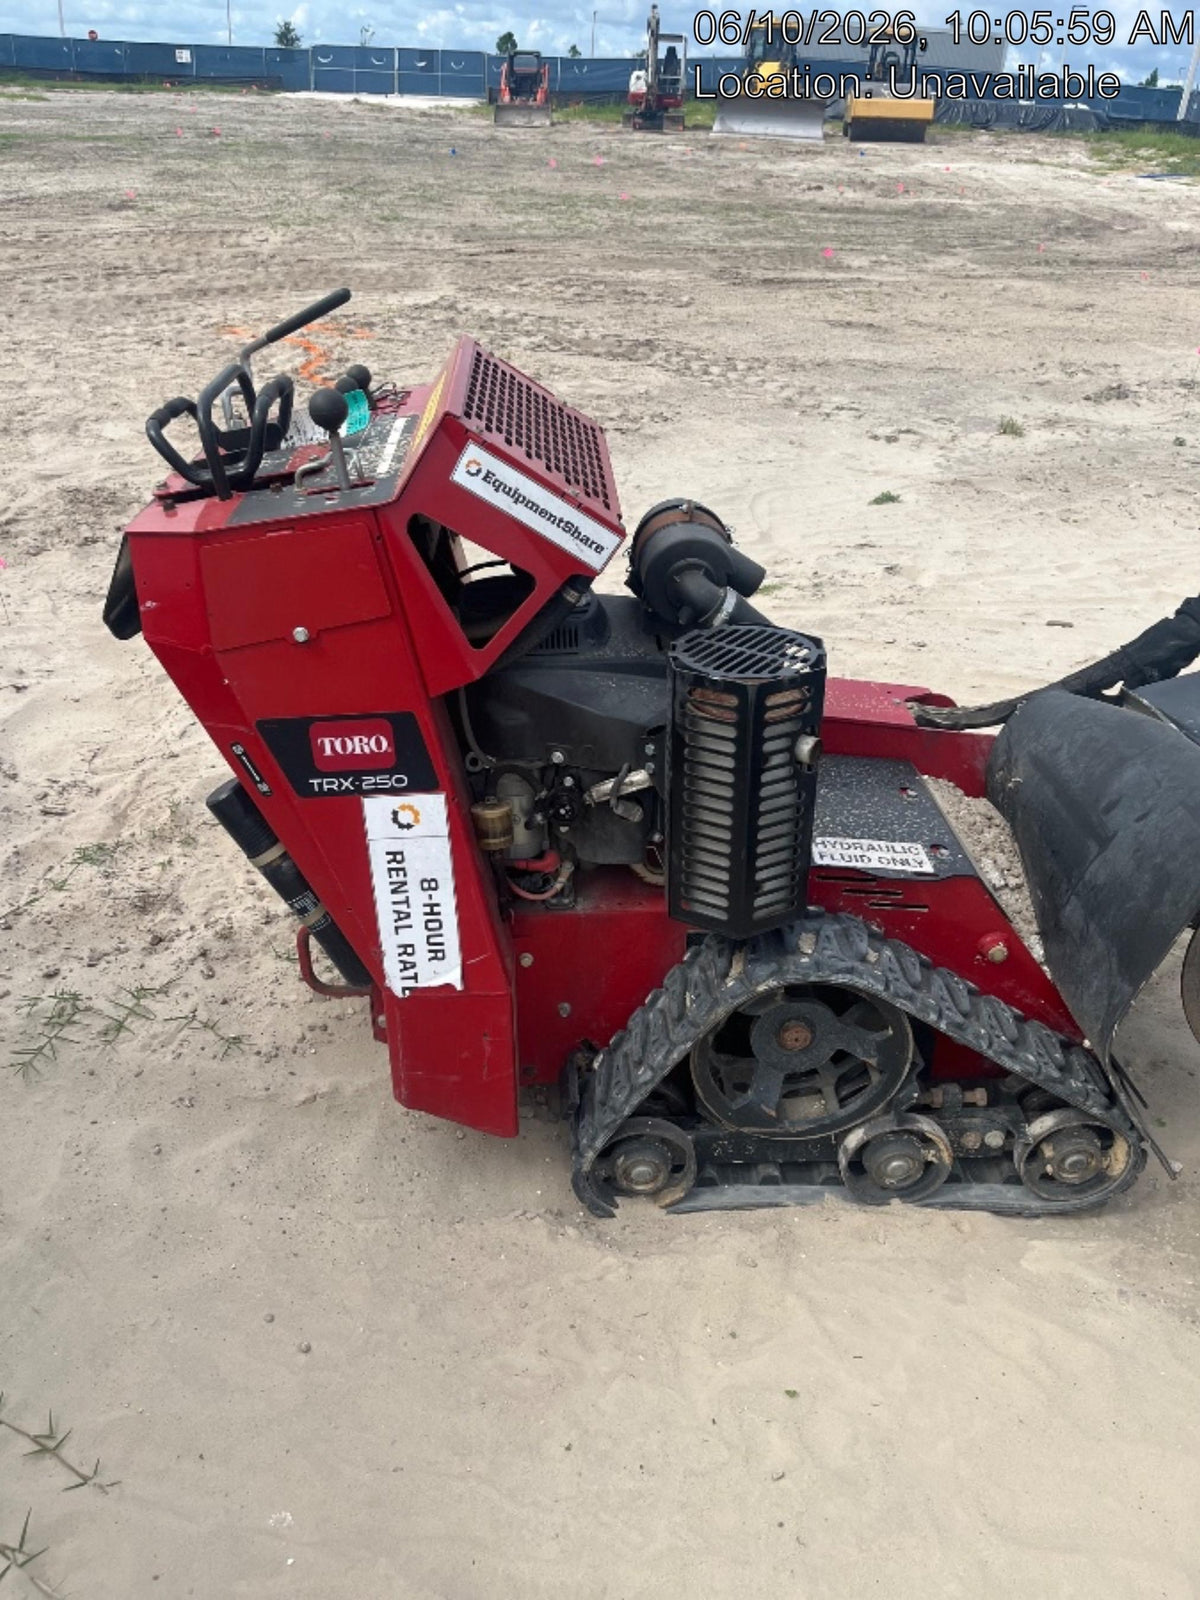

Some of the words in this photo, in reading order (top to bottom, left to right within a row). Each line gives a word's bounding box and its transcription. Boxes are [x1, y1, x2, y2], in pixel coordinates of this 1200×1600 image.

[481, 468, 606, 555] EquipmentShare
[317, 733, 389, 757] TORO
[309, 774, 408, 792] TRX-250
[818, 851, 872, 864] FLUID
[877, 856, 924, 869] ONLY
[385, 850, 413, 936] RENTAL
[420, 877, 446, 962] 8-HOUR
